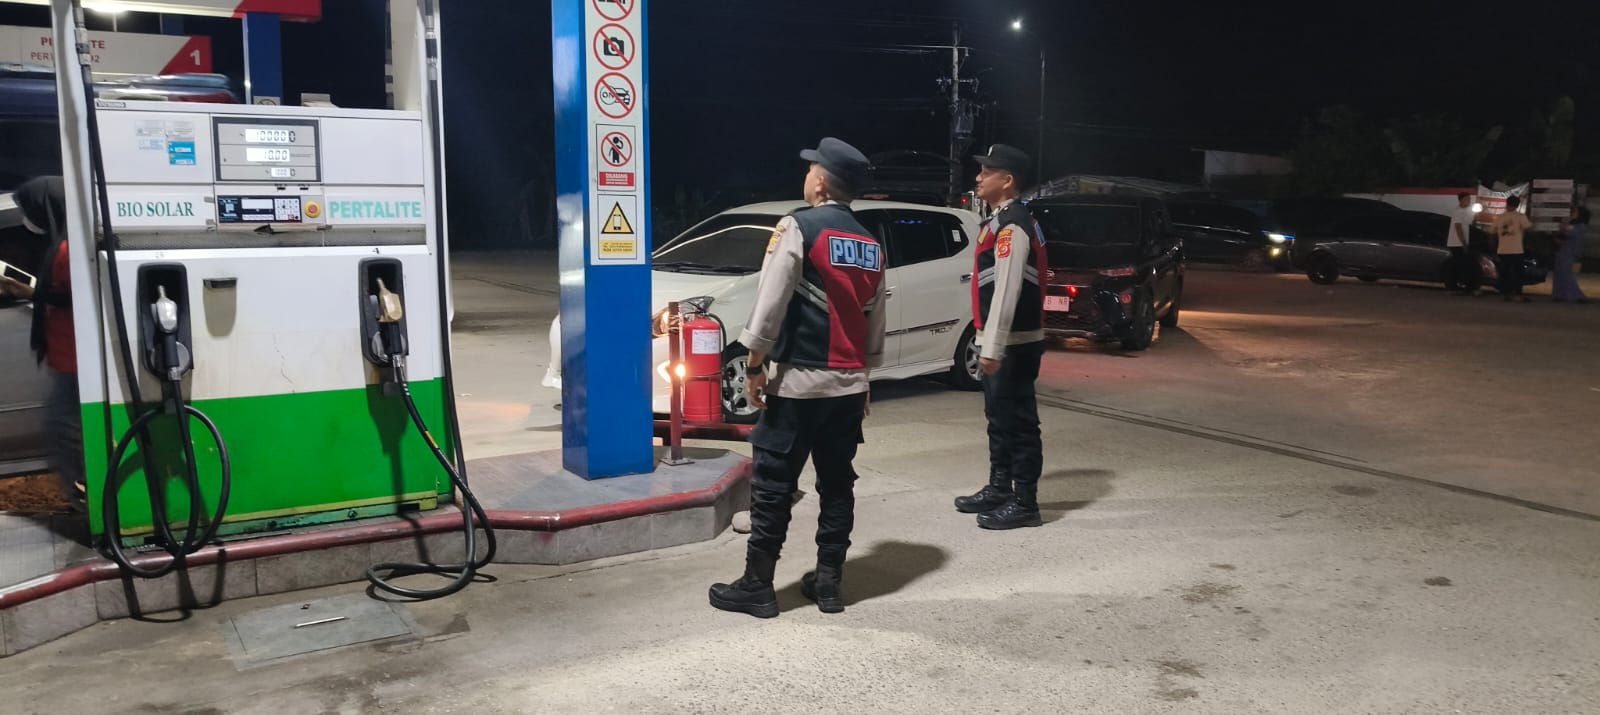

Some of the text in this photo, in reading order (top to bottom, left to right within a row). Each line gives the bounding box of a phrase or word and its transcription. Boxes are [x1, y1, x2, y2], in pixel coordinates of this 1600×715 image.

[190, 49, 201, 66] 1
[116, 201, 195, 218] BIO SOLAR
[329, 200, 423, 219] PERTALITE
[831, 239, 881, 270] POLISI
